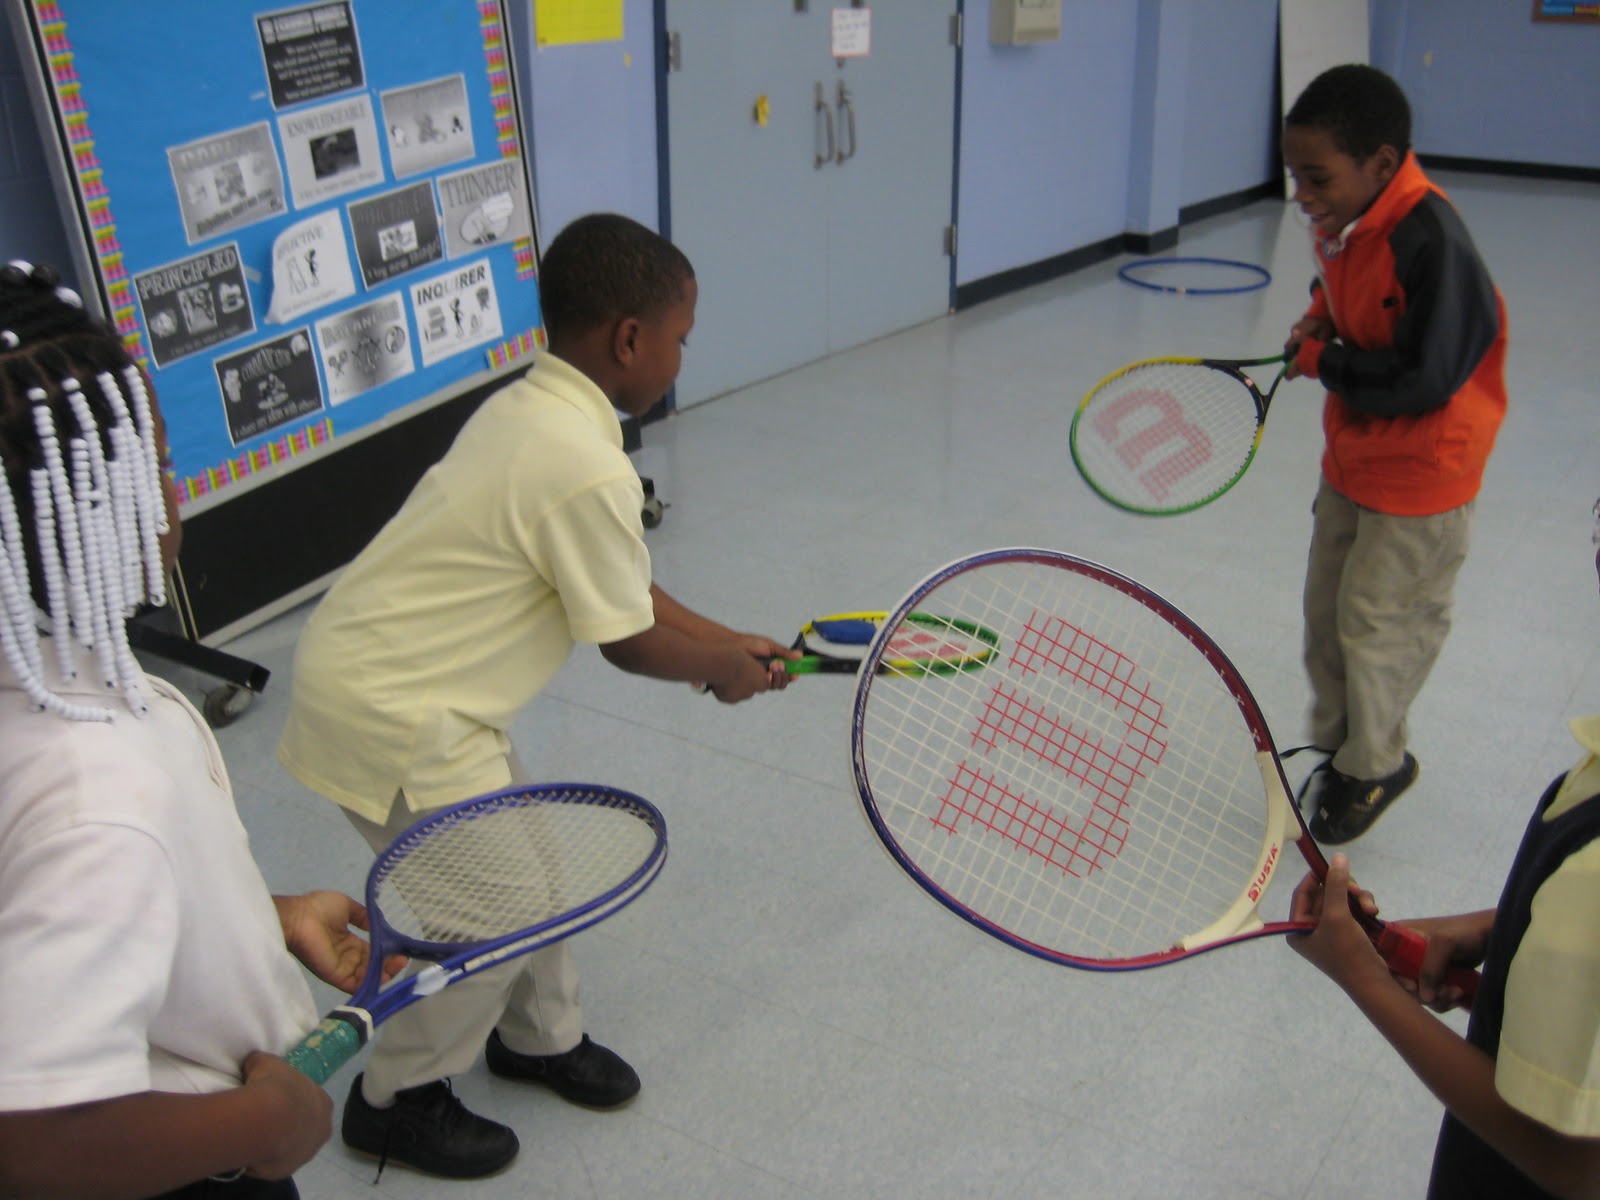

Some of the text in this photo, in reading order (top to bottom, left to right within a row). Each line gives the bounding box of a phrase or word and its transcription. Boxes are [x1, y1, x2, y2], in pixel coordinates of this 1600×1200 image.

[443, 164, 519, 208] THINKER
[138, 248, 237, 300] PRINCIPLED
[417, 266, 486, 306] INQUIRER
[1257, 848, 1279, 886] USTA
